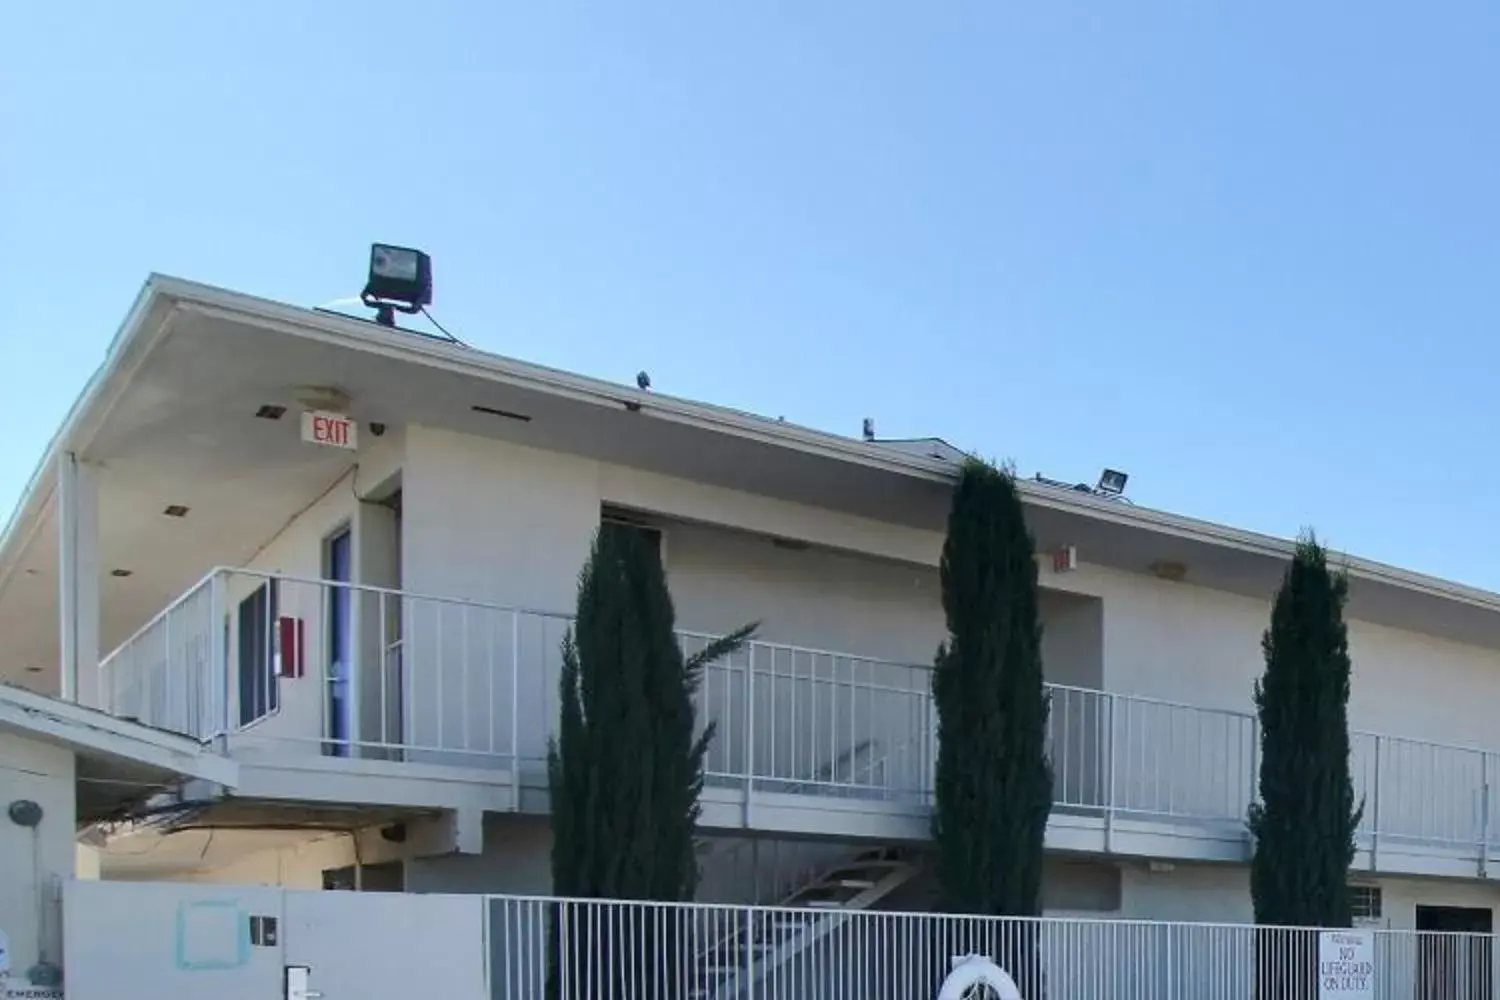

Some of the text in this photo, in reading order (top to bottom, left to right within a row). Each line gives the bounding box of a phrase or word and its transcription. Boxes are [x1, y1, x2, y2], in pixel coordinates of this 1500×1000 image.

[314, 416, 349, 444] EXIT
[1339, 947, 1355, 960] NO
[1321, 961, 1373, 975] LIFEGUARD
[1323, 977, 1339, 990] ON
